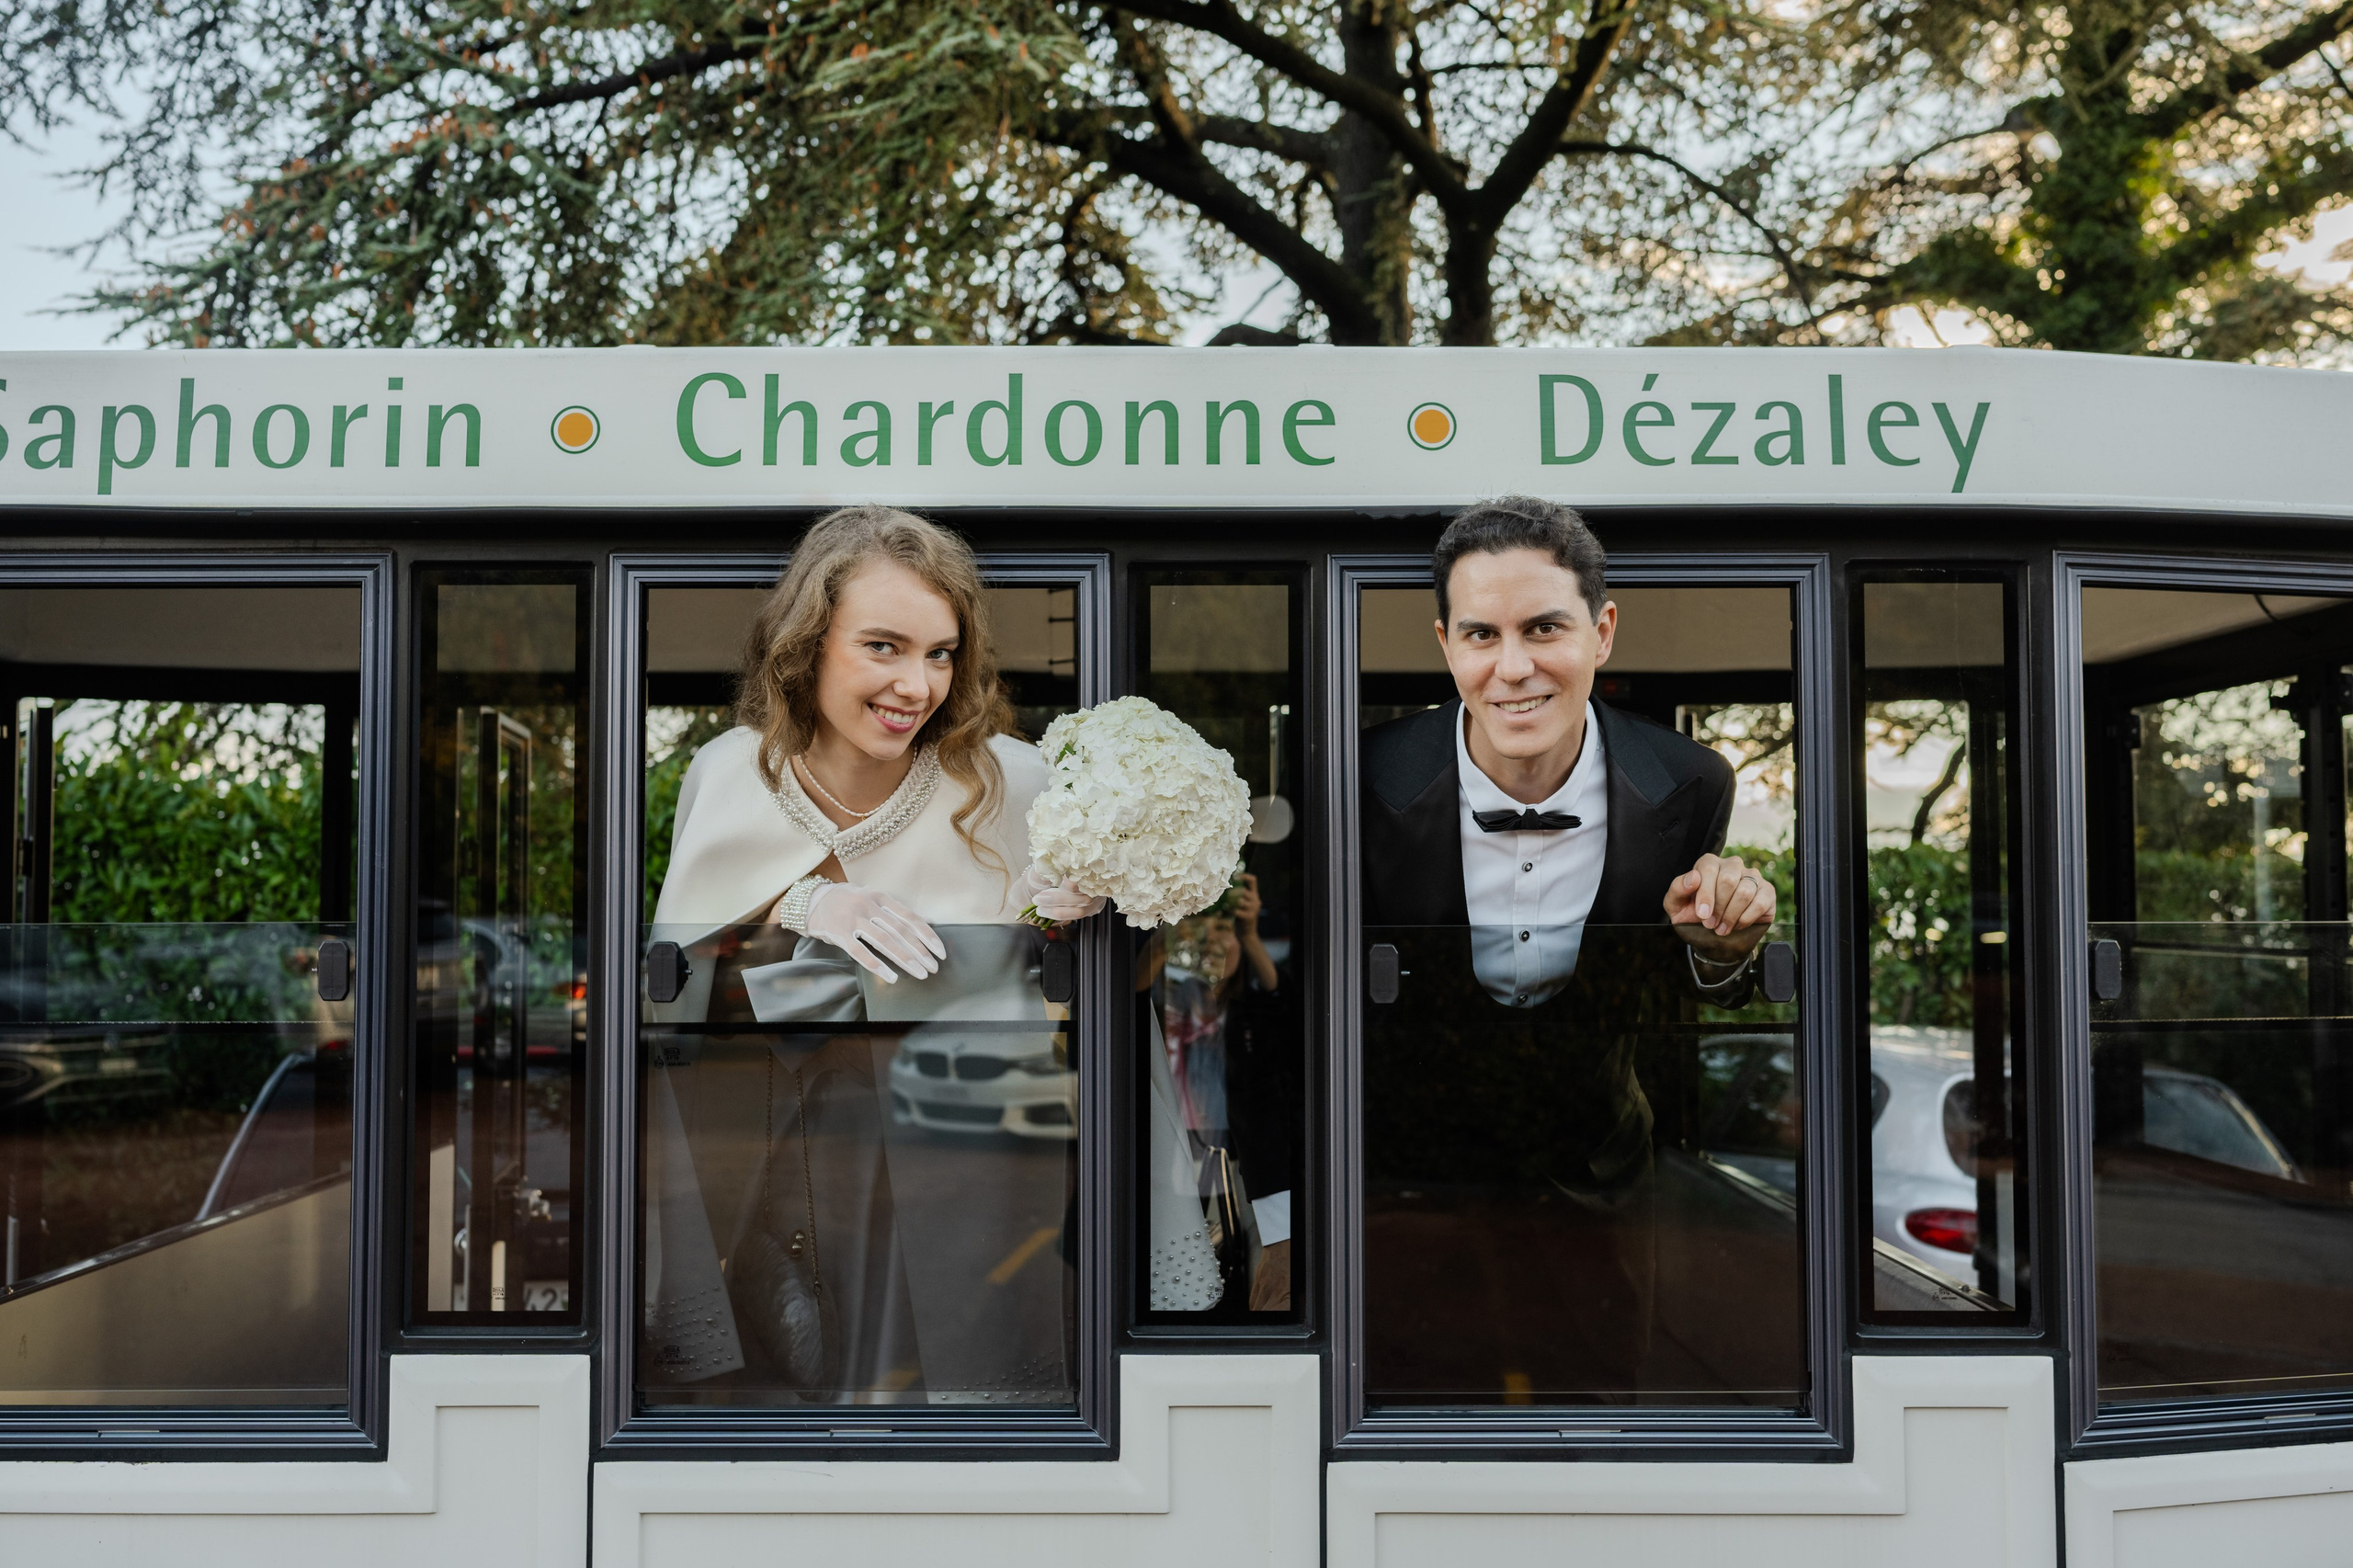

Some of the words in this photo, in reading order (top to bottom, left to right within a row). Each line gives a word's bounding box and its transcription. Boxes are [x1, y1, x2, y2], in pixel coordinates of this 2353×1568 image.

[0, 376, 481, 495] aphorin
[676, 372, 1336, 468] Chardonne
[1539, 373, 1991, 494] Dézaley
